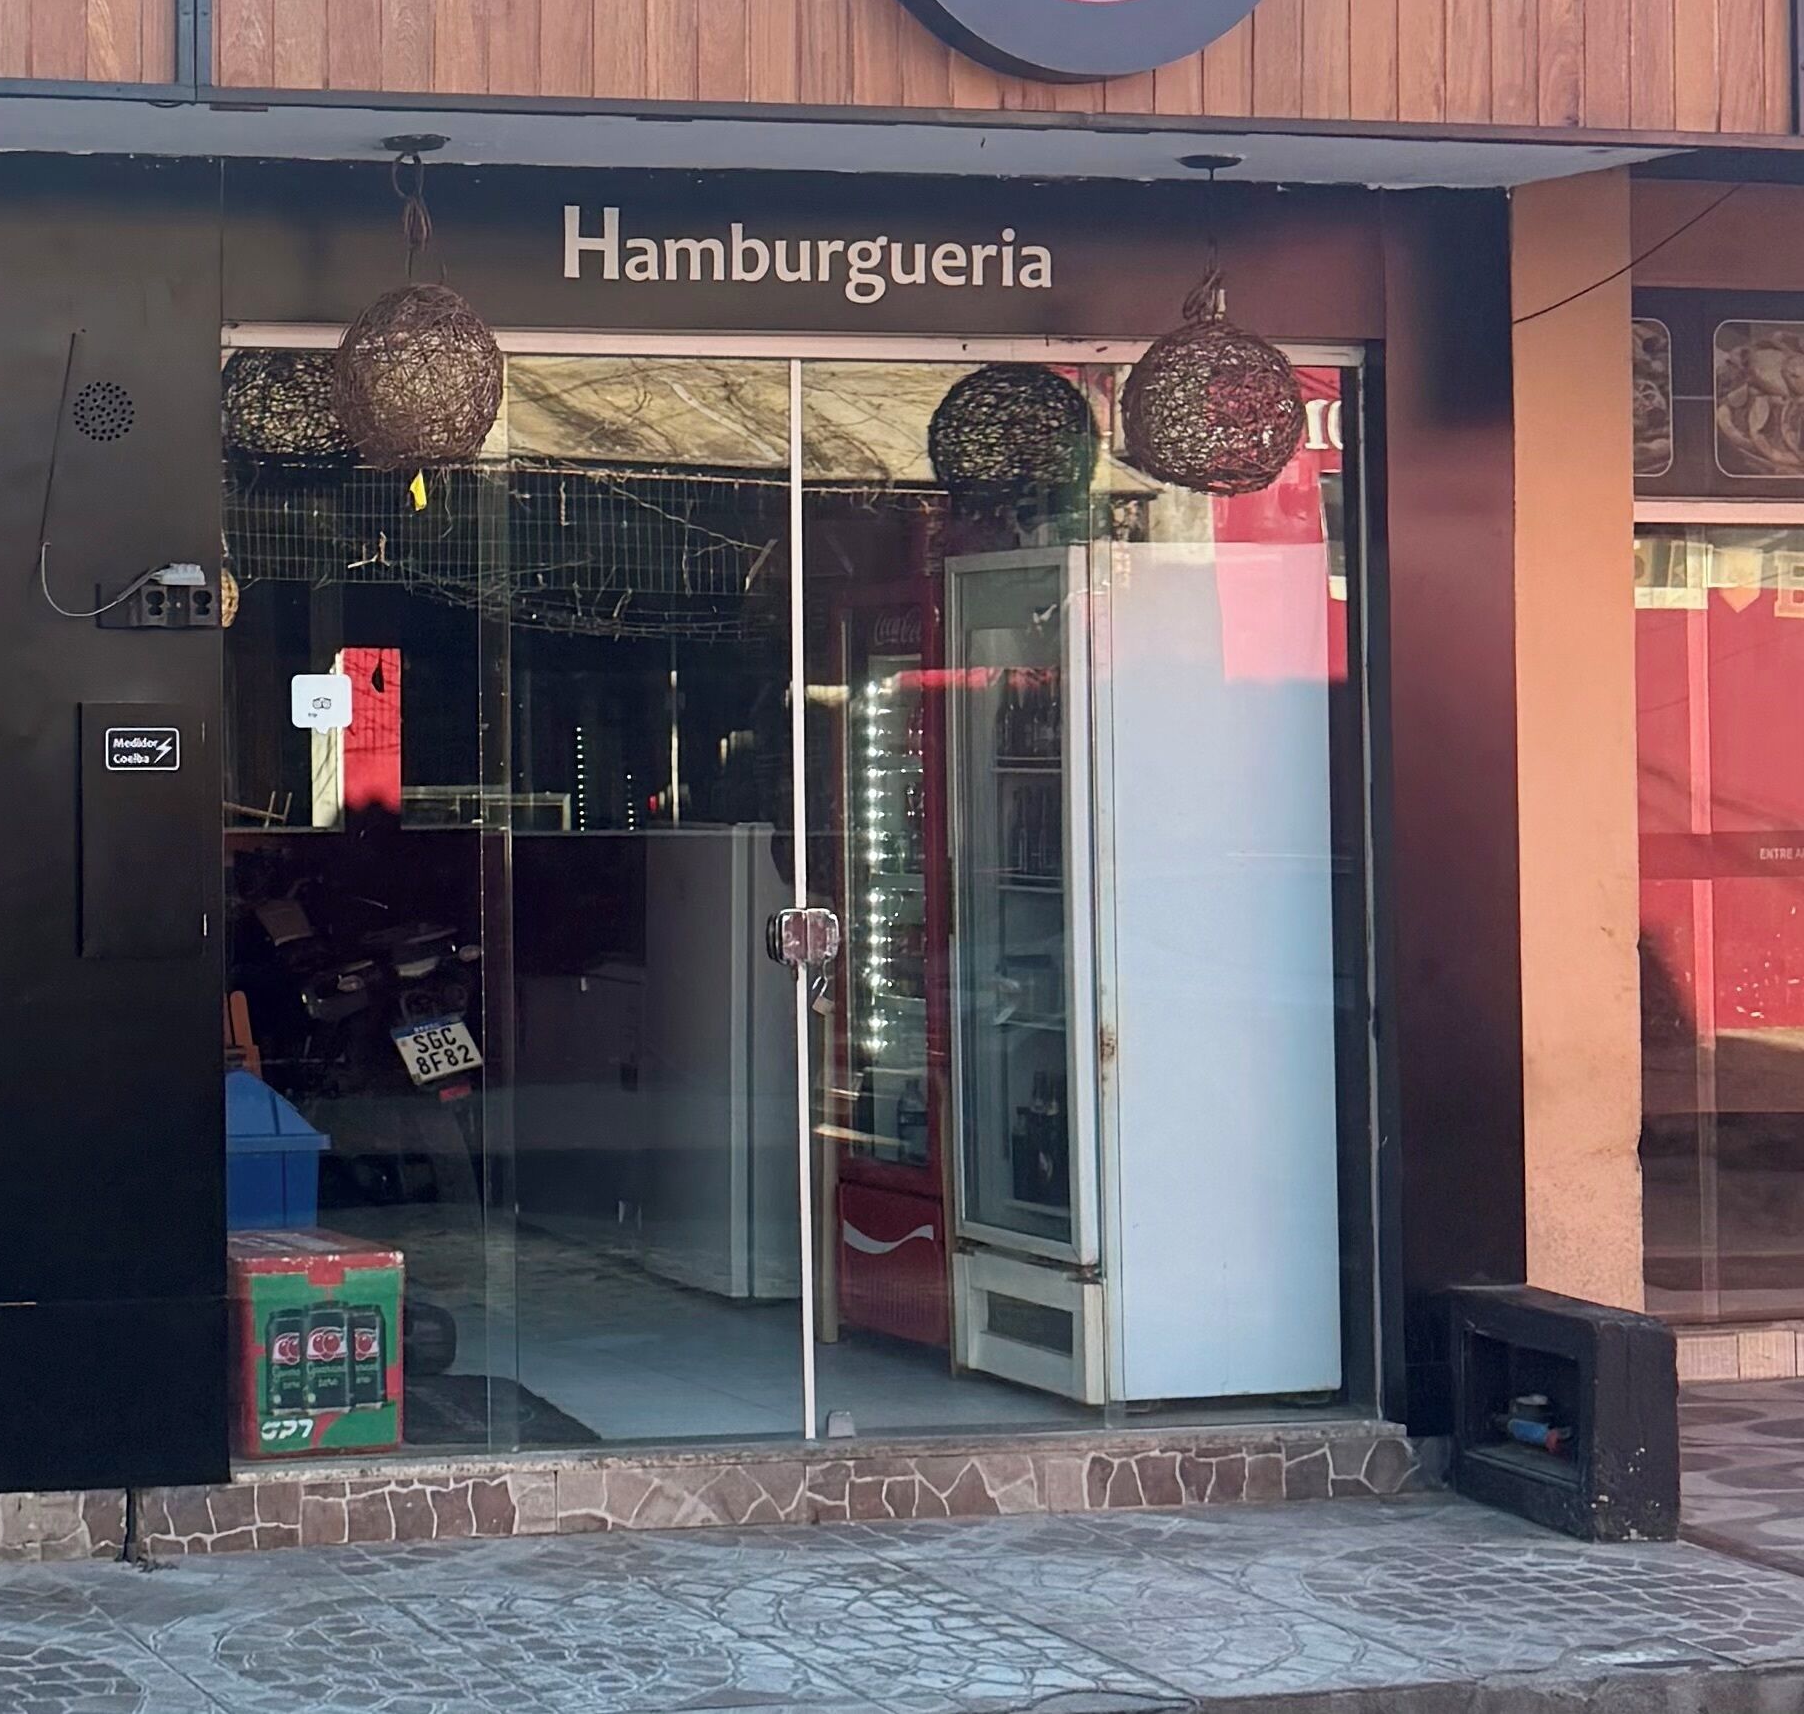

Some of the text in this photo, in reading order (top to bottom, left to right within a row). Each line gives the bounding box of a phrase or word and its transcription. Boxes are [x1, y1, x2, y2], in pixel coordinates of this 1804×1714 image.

[563, 204, 1052, 304] Hamburgueria
[112, 737, 159, 748] Medidor
[1760, 848, 1793, 860] ENTRE
[413, 1027, 457, 1053] SGC
[416, 1044, 475, 1075] 8F82
